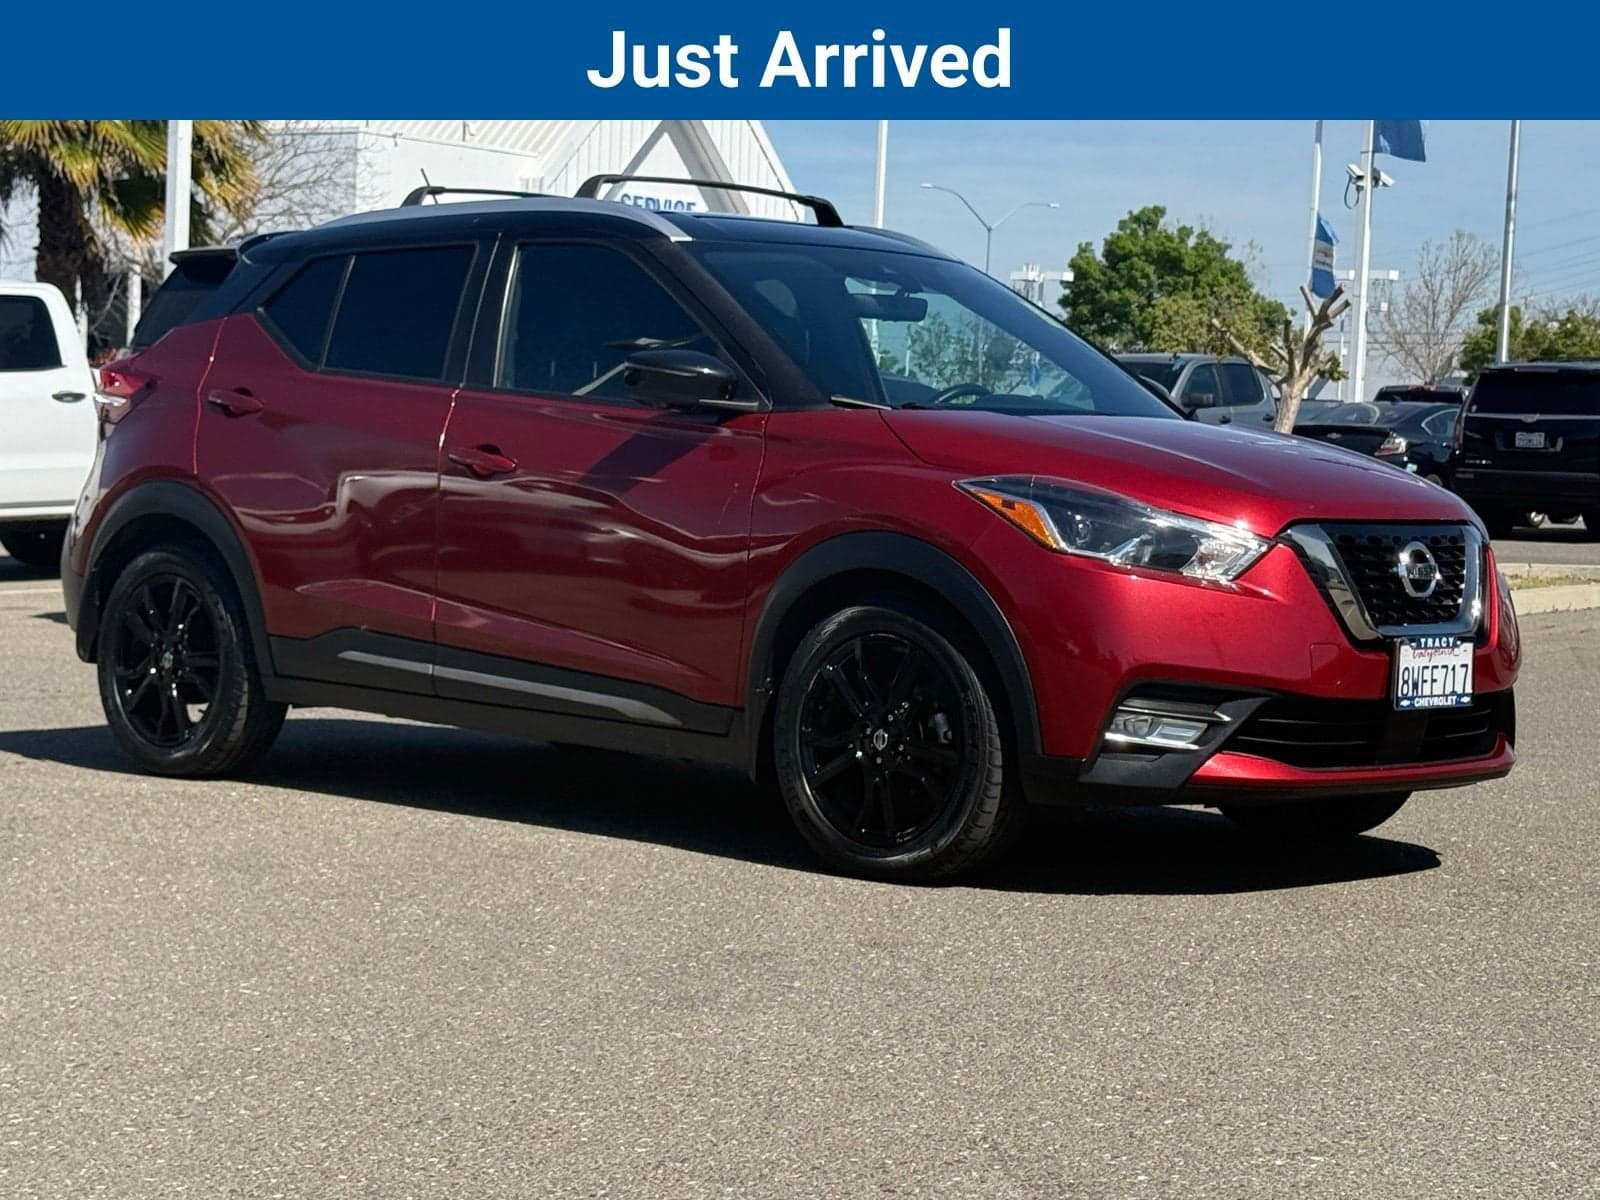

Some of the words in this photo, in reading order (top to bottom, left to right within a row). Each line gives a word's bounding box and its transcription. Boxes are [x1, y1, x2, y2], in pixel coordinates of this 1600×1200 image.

[1420, 637, 1455, 648] TRACY
[1401, 663, 1469, 697] 8WFF717
[1414, 695, 1457, 707] CHEVROLET
